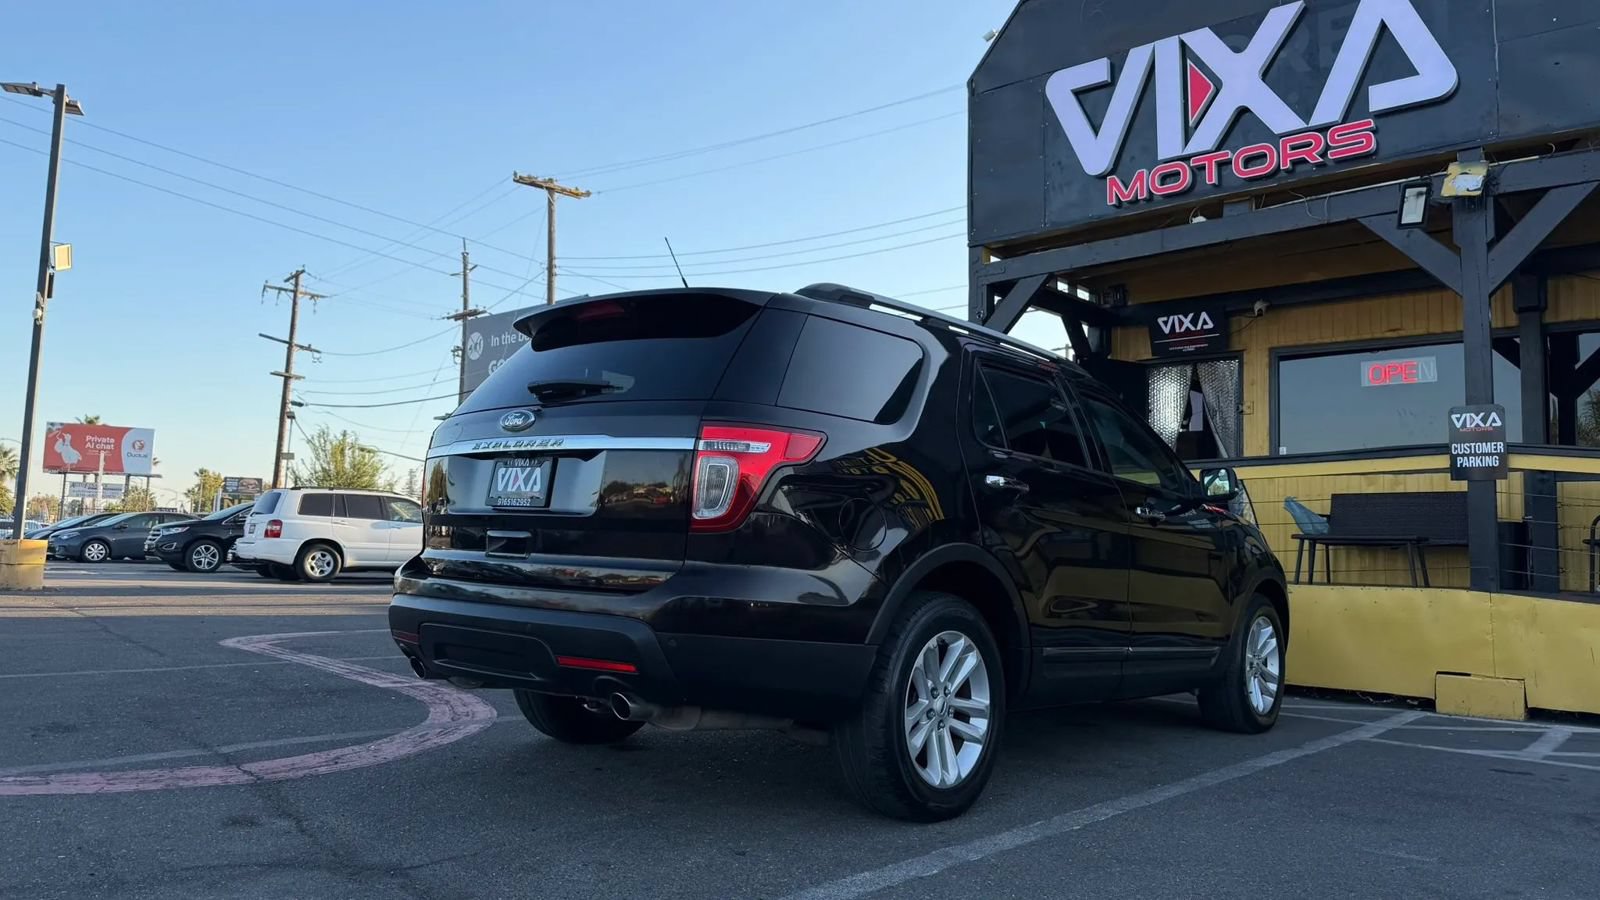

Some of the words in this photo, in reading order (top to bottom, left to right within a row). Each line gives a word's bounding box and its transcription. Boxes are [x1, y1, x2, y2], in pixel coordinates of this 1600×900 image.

[1045, 0, 1460, 176] VIXA
[1106, 118, 1378, 206] MOTORS
[1157, 311, 1214, 335] VIXA
[491, 335, 500, 348] In
[501, 331, 517, 345] the
[1368, 360, 1435, 385] OPEN
[504, 412, 525, 426] Ford
[1450, 411, 1503, 429] VIXA
[86, 434, 115, 444] Private
[96, 442, 115, 450] chat
[472, 438, 564, 450] EXPLORER
[1451, 441, 1504, 455] CUSTOMER
[1456, 455, 1500, 468] PARKING
[497, 467, 541, 492] VIXA
